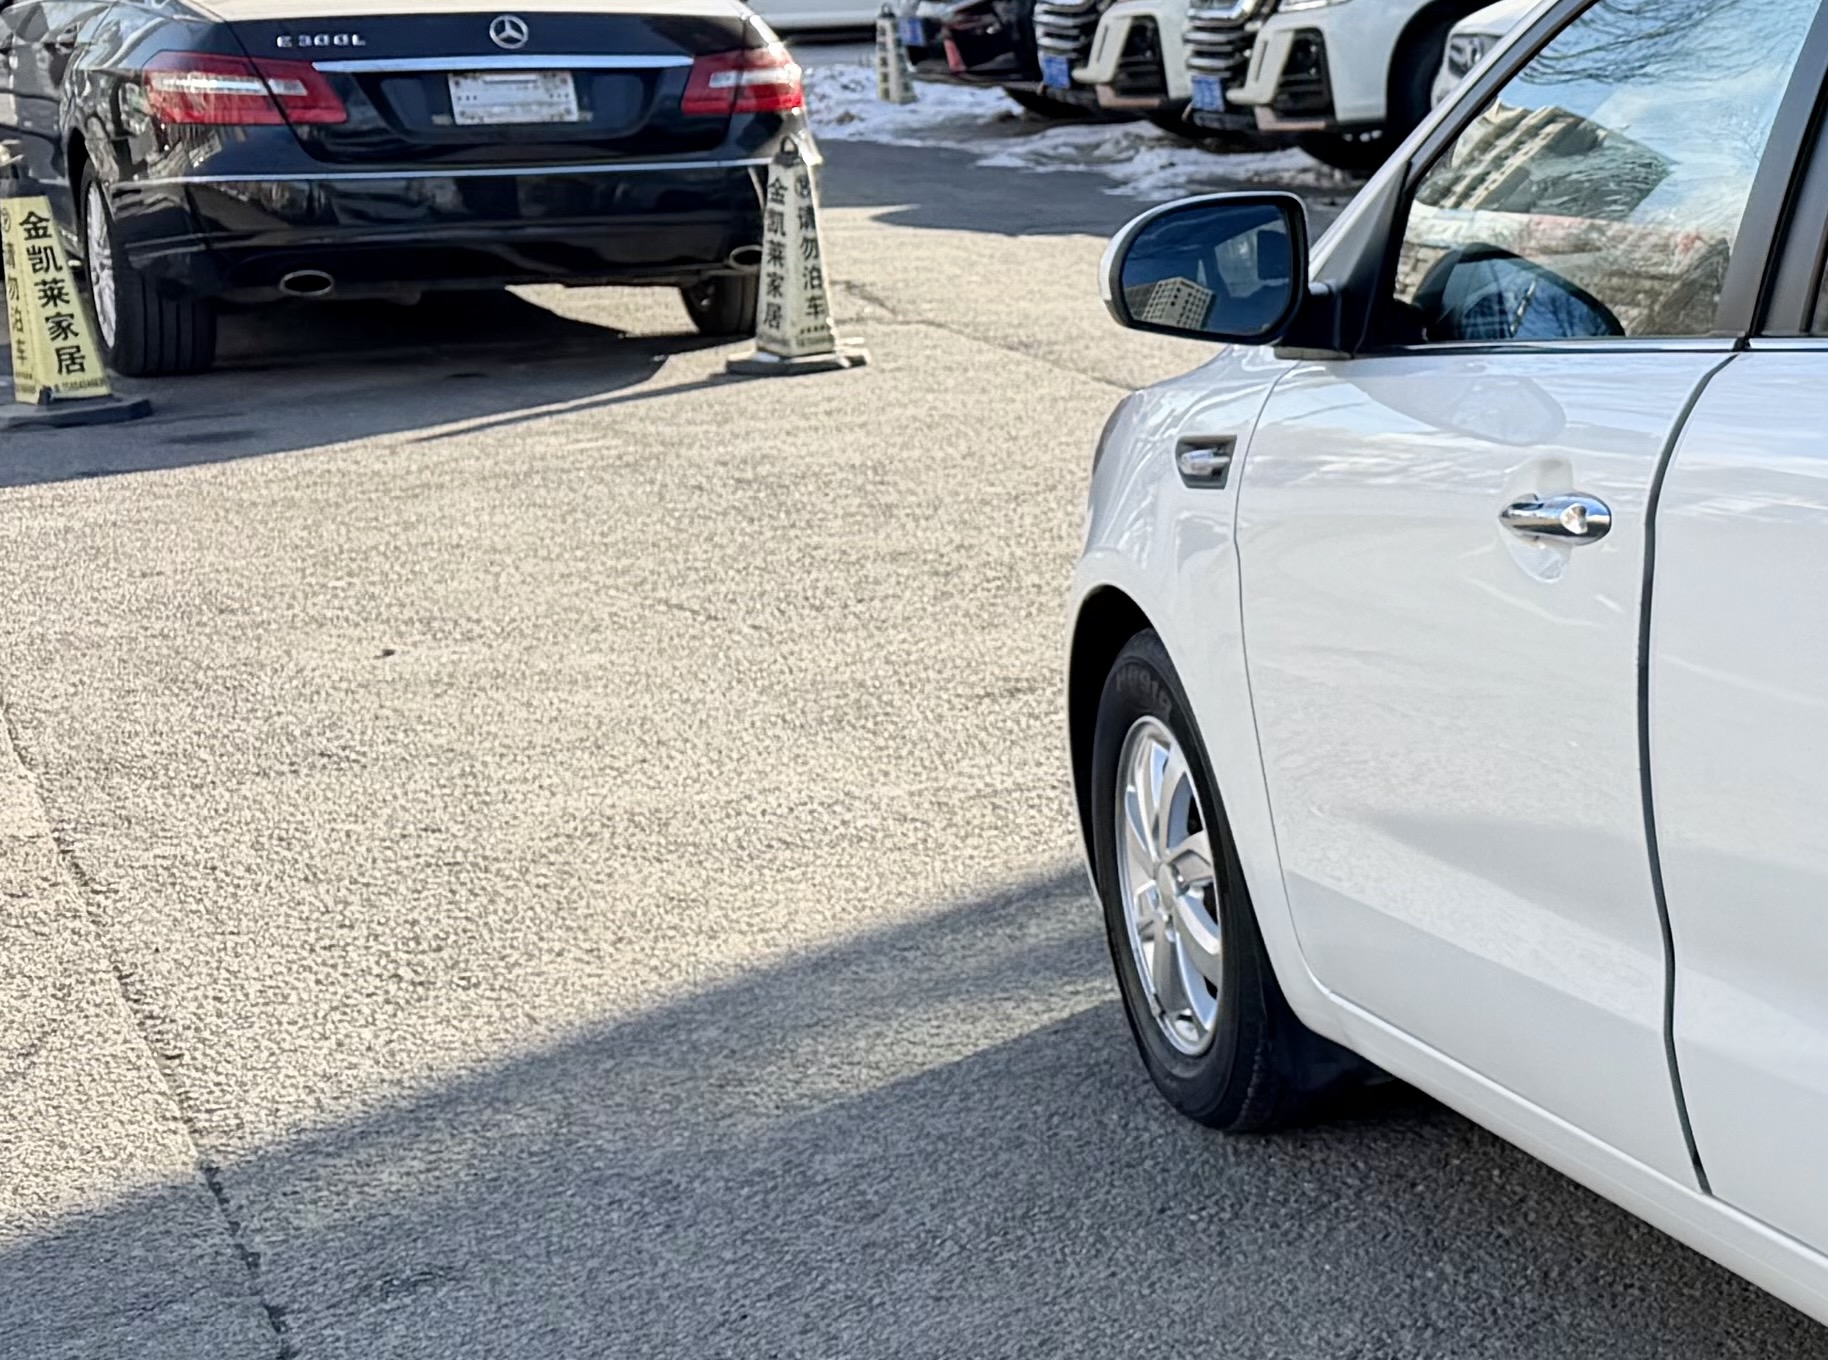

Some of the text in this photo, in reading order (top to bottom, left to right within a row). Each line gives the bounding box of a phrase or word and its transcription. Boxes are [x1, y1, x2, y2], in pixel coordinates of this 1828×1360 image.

[19, 211, 87, 376] 金凯莱家居
